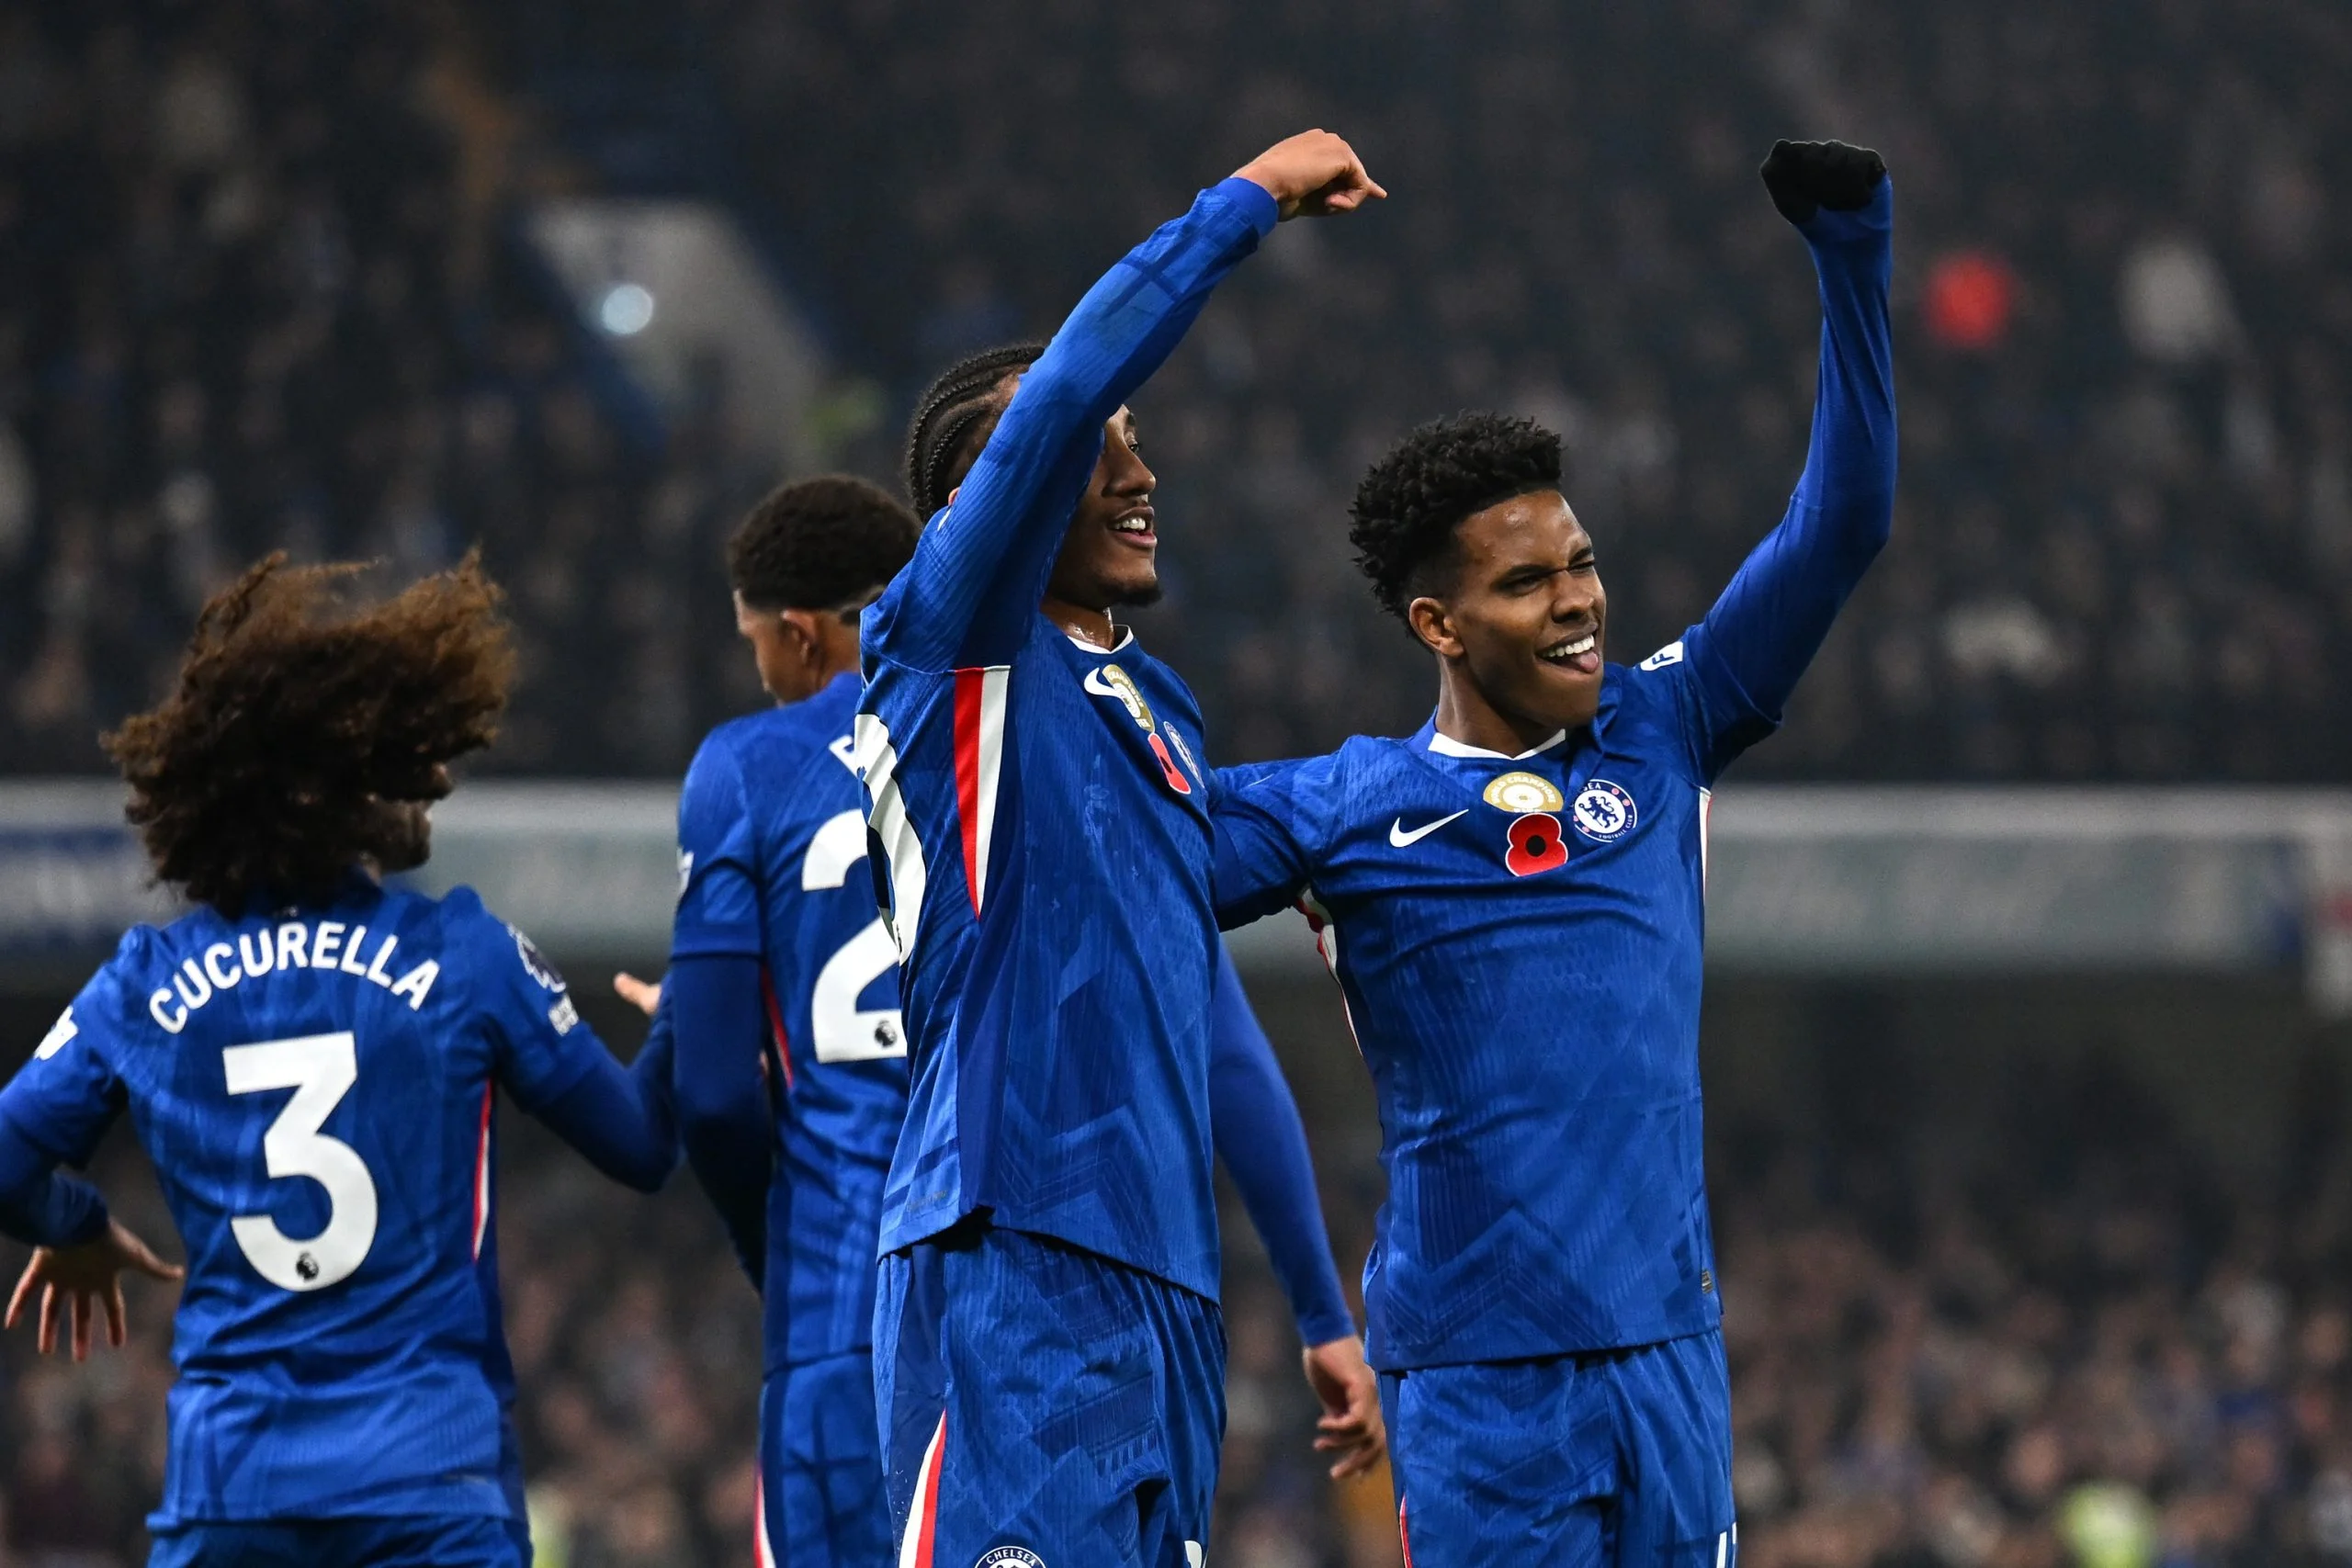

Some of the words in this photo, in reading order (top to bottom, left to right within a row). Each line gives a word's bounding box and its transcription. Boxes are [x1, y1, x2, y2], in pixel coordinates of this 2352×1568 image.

[148, 921, 440, 1033] CUCURELLA
[222, 1031, 379, 1292] 3
[986, 1549, 1037, 1567] CHELSEA
